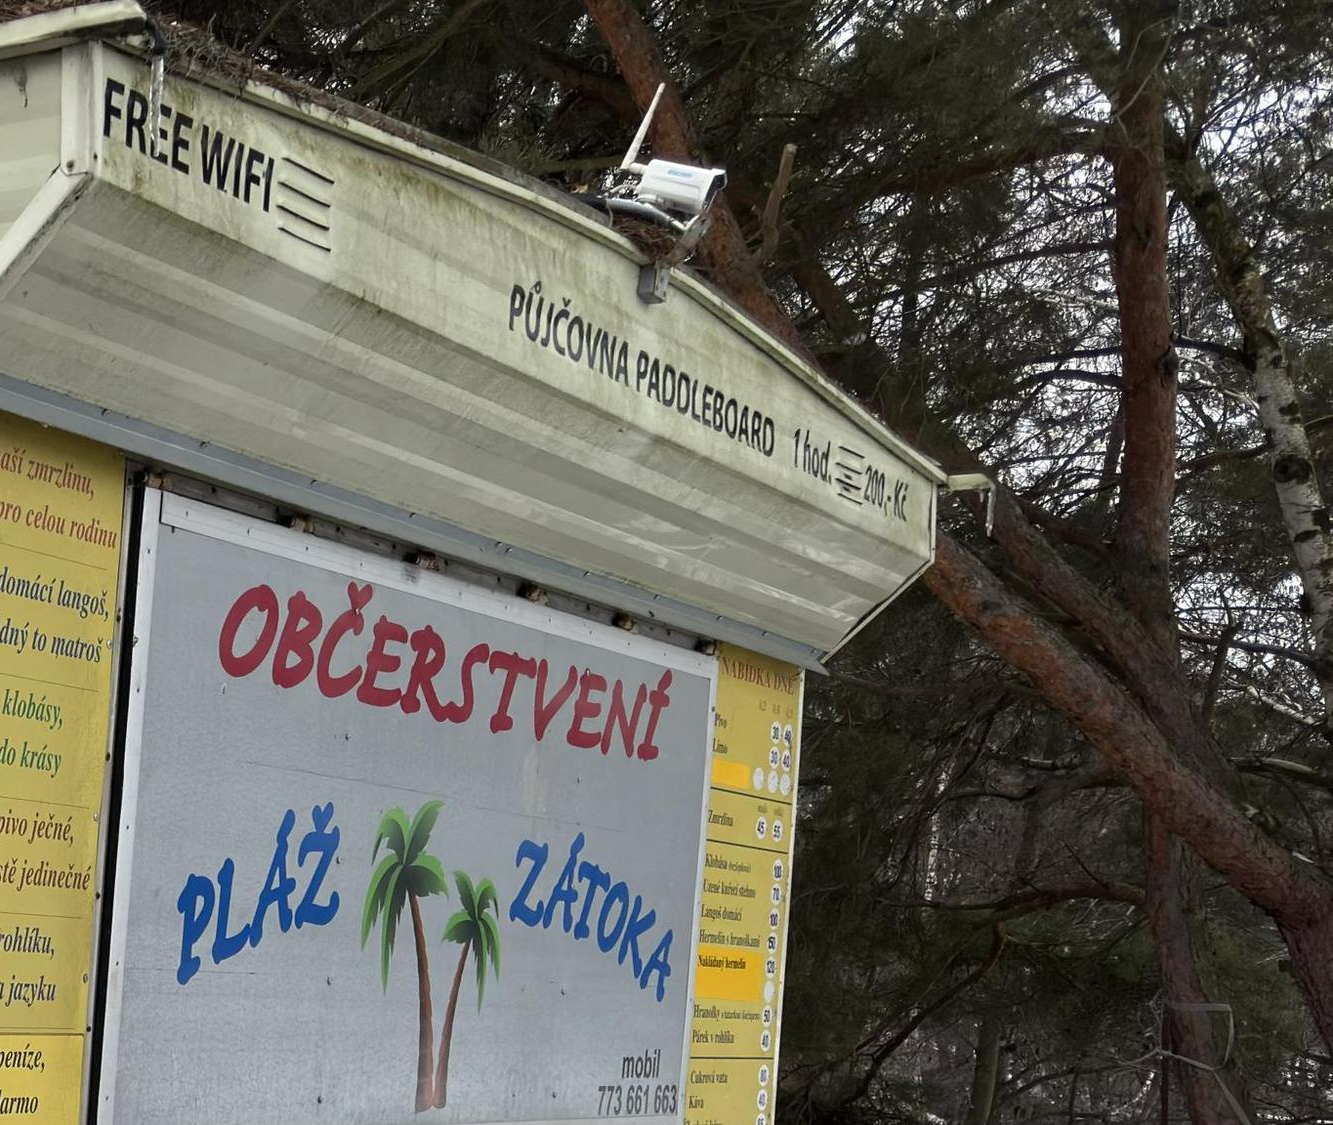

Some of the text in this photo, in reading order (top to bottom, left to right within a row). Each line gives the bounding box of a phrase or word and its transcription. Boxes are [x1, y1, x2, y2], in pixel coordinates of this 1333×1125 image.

[103, 77, 275, 213] FREE WIFI
[508, 280, 630, 388] PŮJČOVNA
[636, 349, 775, 458] PADDLEBOARD
[792, 428, 801, 468] 1
[803, 428, 832, 486] hod.
[893, 479, 910, 522] Kč
[27, 461, 95, 502] zmrzlinu,
[25, 504, 66, 536] celou
[68, 518, 118, 549] rodinu
[56, 580, 109, 622] langoš,
[31, 627, 47, 652] to
[51, 634, 104, 663] matroš
[219, 581, 672, 761] OBČERSTVENÍ
[1, 688, 64, 731] klobásy,
[20, 741, 63, 779] krásy
[28, 812, 74, 846] ječné,
[16, 859, 92, 892] jedinečné
[176, 802, 673, 1001] PLÁŽ ZÁTOKA
[4, 974, 57, 1007] jazyku
[621, 1049, 662, 1079] mobil
[597, 1084, 677, 1116] 773 661 663
